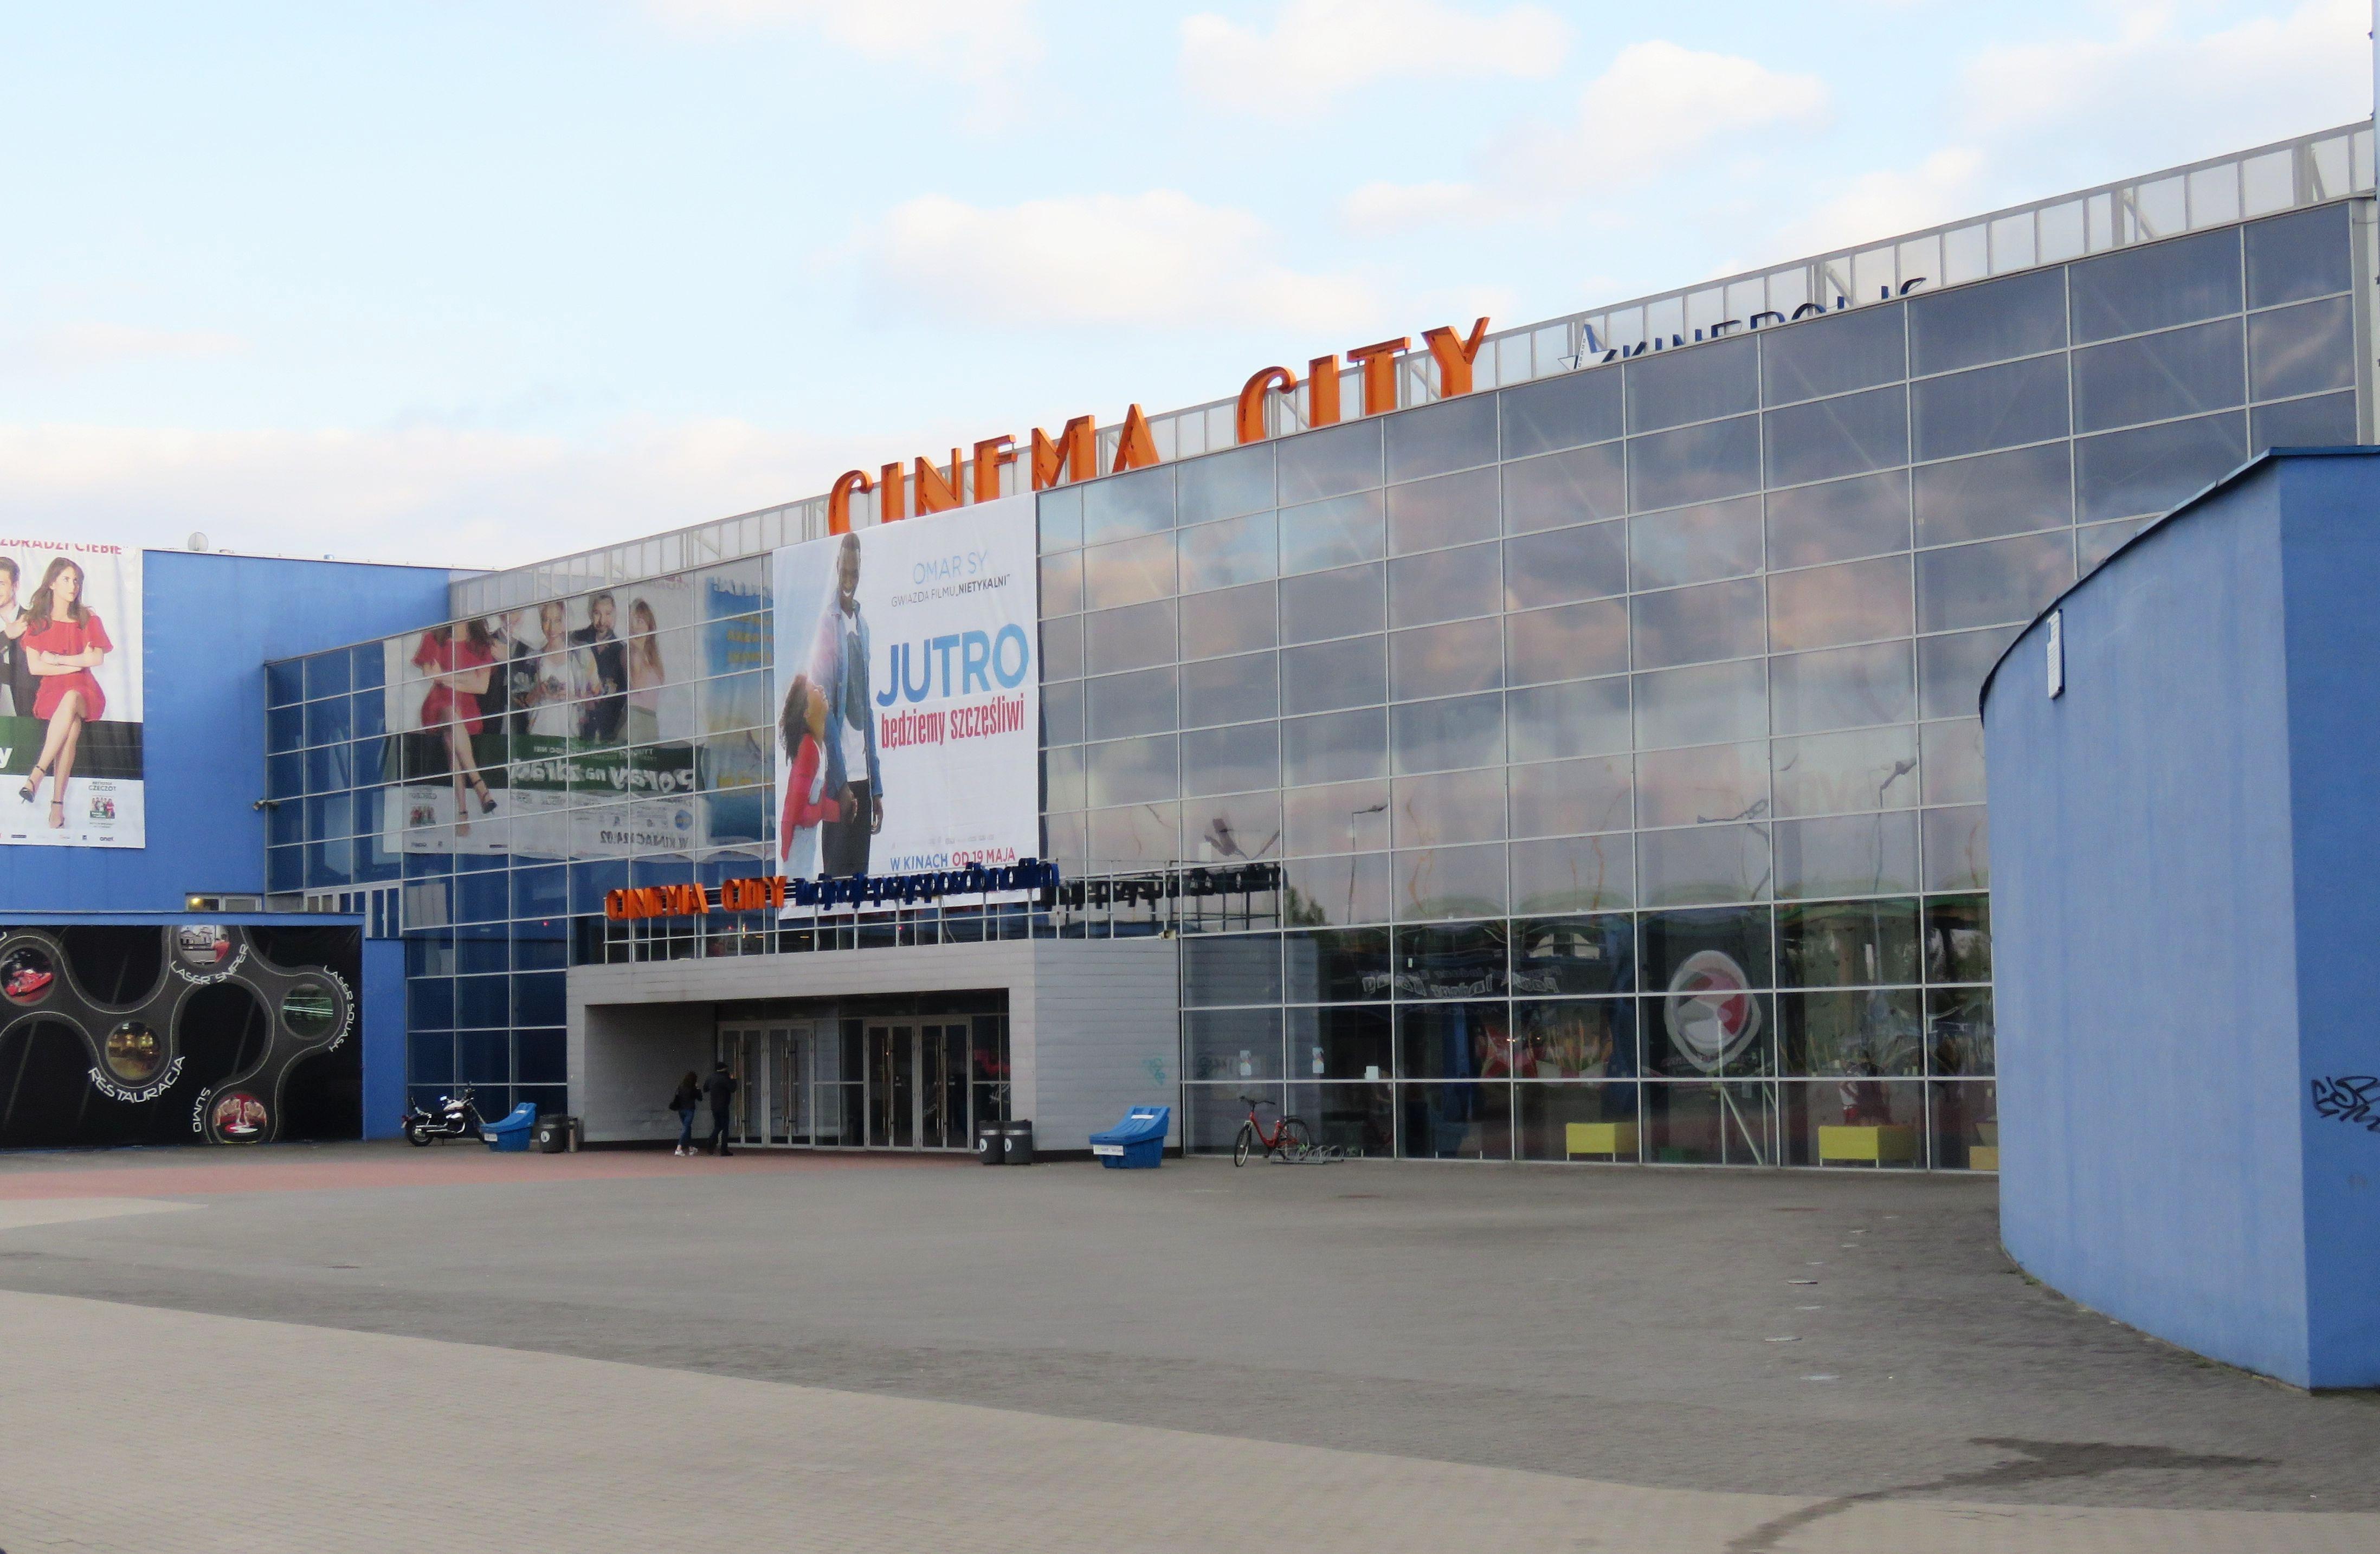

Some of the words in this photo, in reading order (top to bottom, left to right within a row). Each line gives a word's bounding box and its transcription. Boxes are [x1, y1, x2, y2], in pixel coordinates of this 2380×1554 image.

[829, 405, 1159, 536] CINEMA
[1237, 317, 1491, 444] CITY
[913, 555, 962, 584] OMAR
[968, 550, 988, 574] SY
[891, 591, 930, 607] GWIAZDA
[931, 585, 955, 599] FILMU
[876, 624, 1029, 707] JUTRO
[881, 708, 945, 751] będziemy
[951, 692, 1024, 740] szczęśliwi
[889, 857, 900, 871] W
[904, 853, 948, 871] KINACH
[952, 851, 970, 867] OD
[972, 850, 984, 864] 19
[986, 847, 1016, 864] MAJA
[170, 960, 211, 985] LASER
[323, 965, 353, 1001] LASER
[328, 1003, 355, 1053] SQUASH
[88, 1055, 185, 1103] RESTAURACJA
[193, 1087, 211, 1133] SUMO
